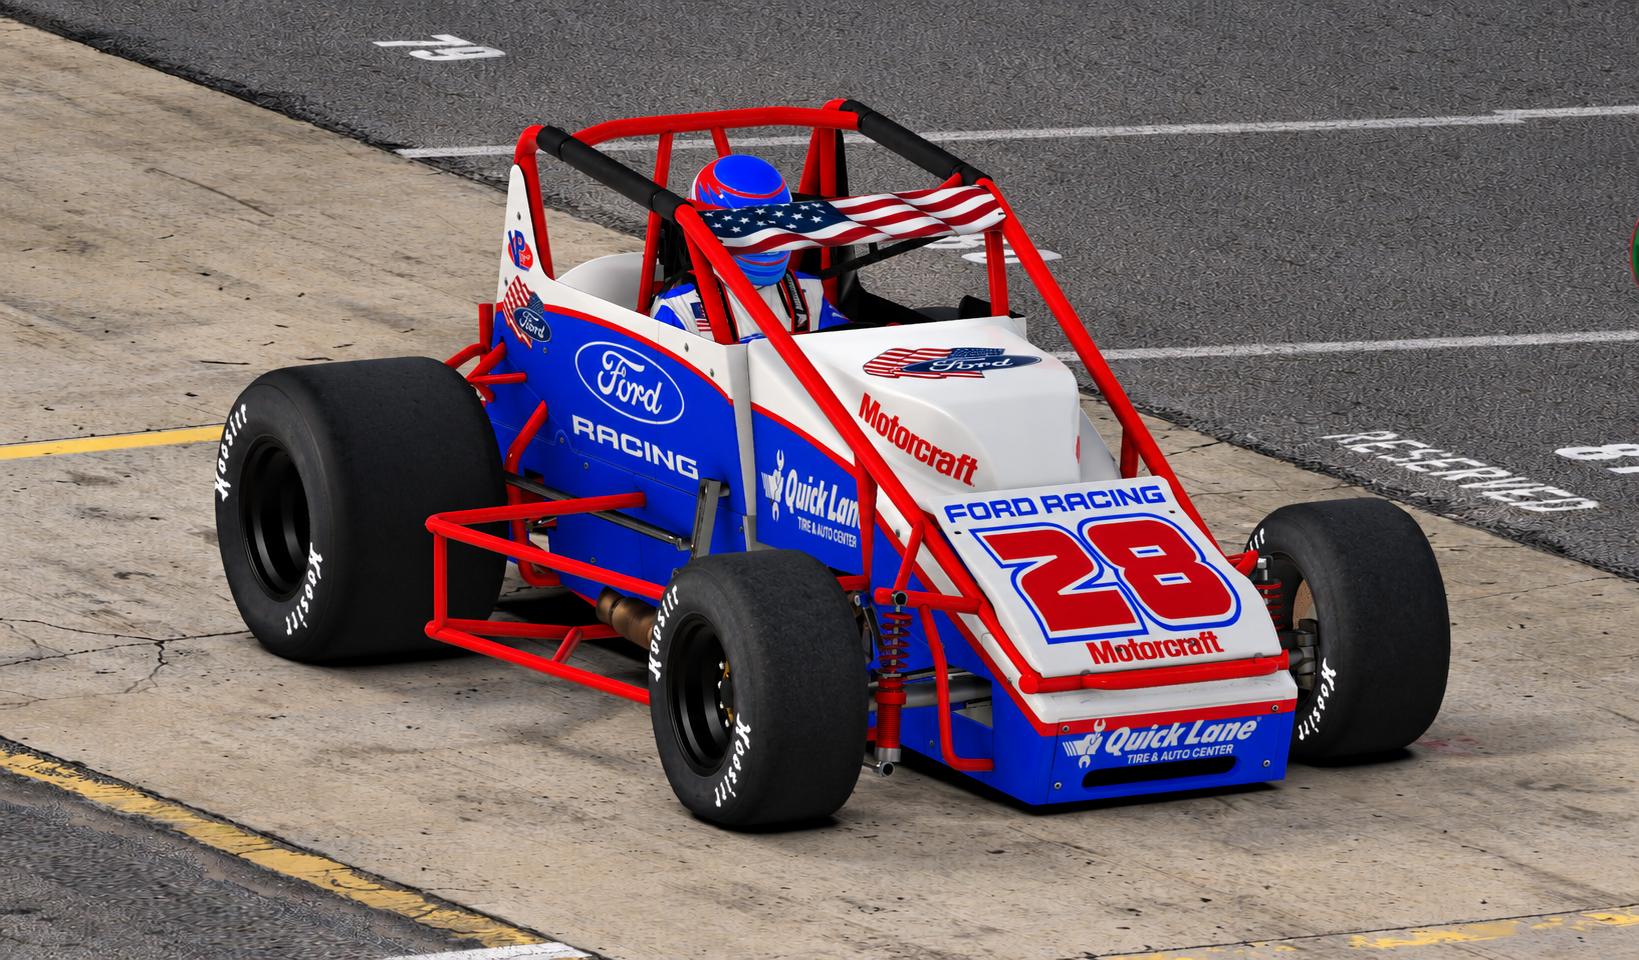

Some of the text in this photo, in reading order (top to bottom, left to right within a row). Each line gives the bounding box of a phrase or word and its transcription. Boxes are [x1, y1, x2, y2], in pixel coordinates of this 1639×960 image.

[373, 34, 506, 61] 79
[519, 310, 545, 338] Ford
[597, 350, 663, 414] Ford
[929, 356, 1013, 371] Ford
[572, 414, 699, 480] RACING
[858, 392, 978, 486] Motorcraft
[1318, 431, 1599, 512] RESERVED
[1554, 443, 1639, 474] 8
[785, 469, 861, 530] Quick Lan
[944, 485, 1167, 523] FORD RACING
[817, 523, 833, 541] AUTO
[833, 529, 857, 548] CENTER
[969, 512, 1242, 645] 28
[1086, 631, 1225, 665] Motorcraft
[1105, 719, 1258, 757] Quick Lane
[1127, 744, 1234, 765] TIRE & AUTO CENTER
